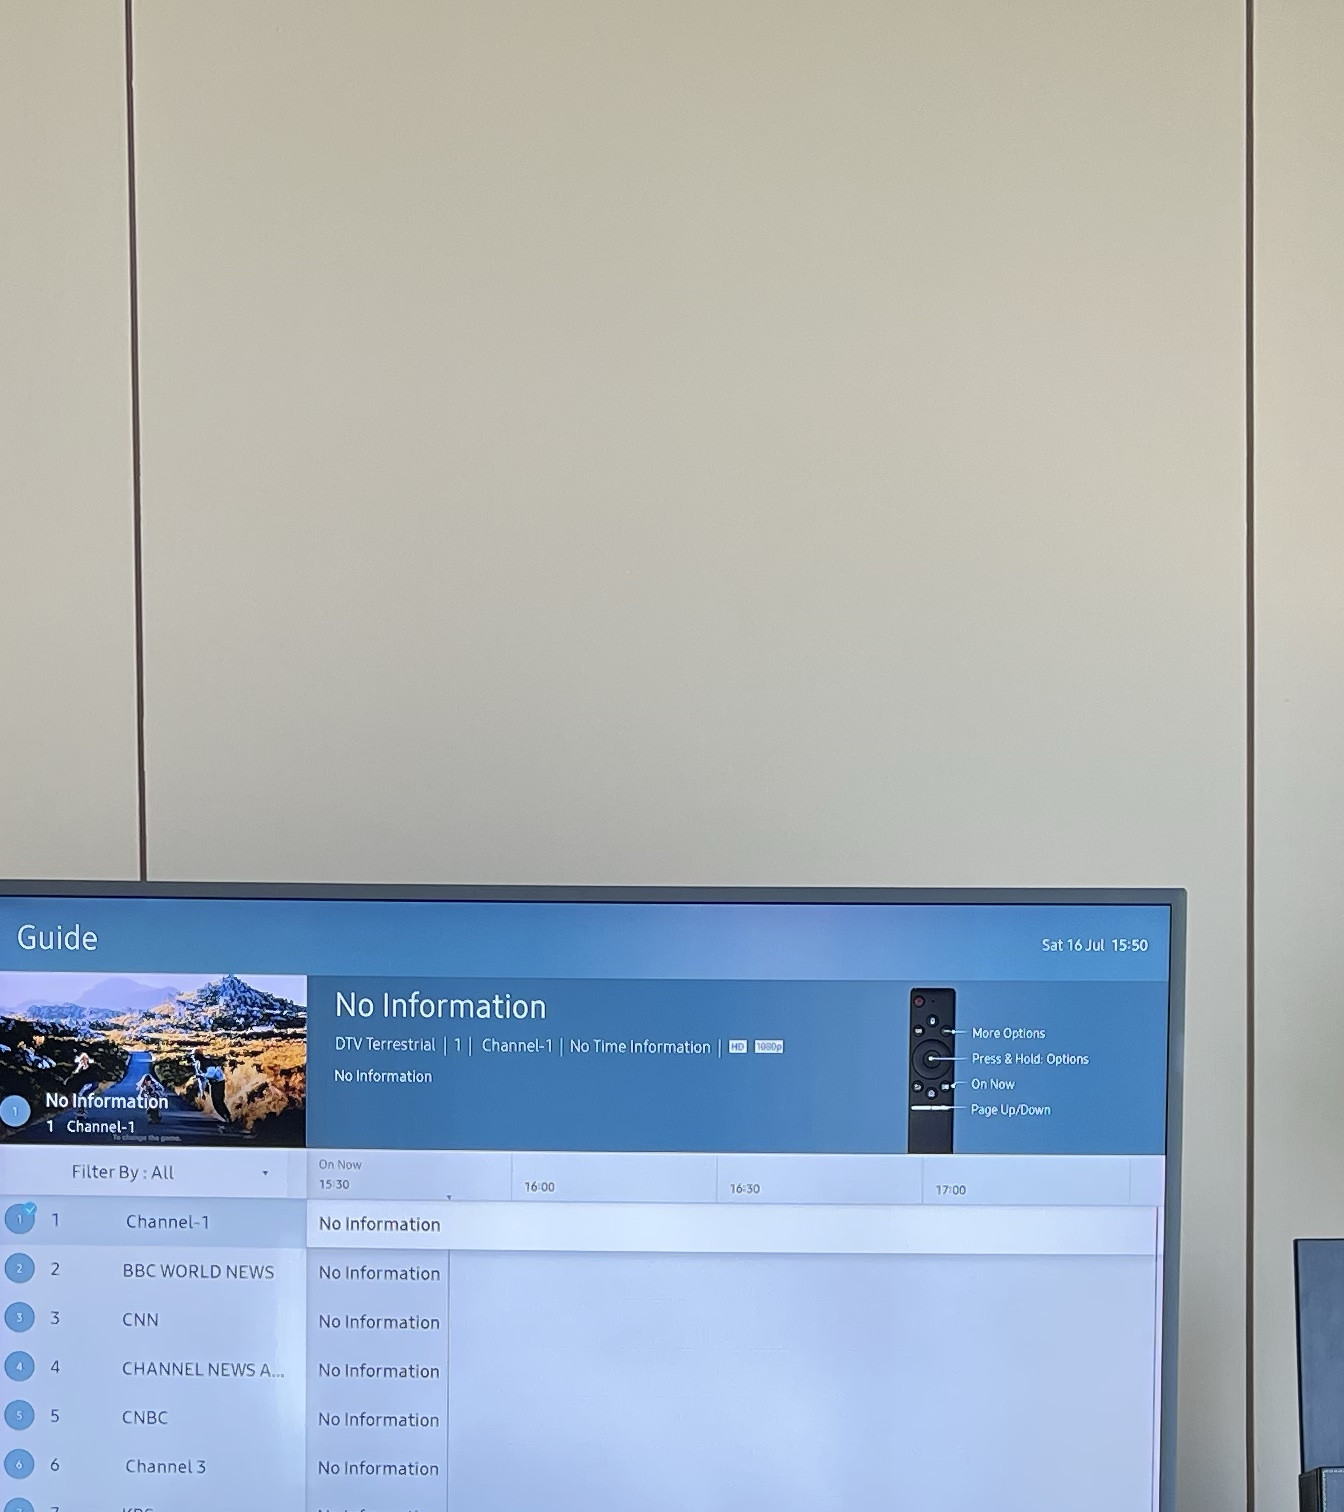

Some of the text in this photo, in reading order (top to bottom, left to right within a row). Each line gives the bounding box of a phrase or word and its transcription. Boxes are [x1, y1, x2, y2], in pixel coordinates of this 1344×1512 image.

[17, 923, 99, 951] Guide
[1042, 937, 1150, 953] Sat 16 Jul 15:50
[336, 990, 547, 1019] No Information
[971, 1027, 1047, 1041] More Options
[335, 1036, 364, 1051] DTV
[365, 1036, 436, 1052] Terrestrial
[454, 1037, 462, 1052] 1
[481, 1037, 553, 1053] Channel-1
[570, 1038, 591, 1053] No
[592, 1038, 627, 1054] Time
[630, 1038, 711, 1054] Information
[972, 1052, 1003, 1066] Press
[1004, 1052, 1014, 1065] &
[1045, 1052, 1091, 1067] Options
[334, 1068, 434, 1083] No Information
[971, 1077, 1017, 1090] On Now
[45, 1092, 169, 1110] No Information
[971, 1103, 1053, 1118] Page Up/Down
[46, 1119, 135, 1134] 1 Channel-1
[318, 1159, 363, 1170] On Now
[72, 1164, 115, 1179] Filter
[119, 1165, 139, 1183] By
[151, 1165, 174, 1180] All
[319, 1179, 350, 1190] 15:30
[524, 1180, 555, 1192] 16:00
[730, 1183, 761, 1194] 16:30
[936, 1184, 967, 1196] 17:00
[52, 1212, 59, 1227] 1
[126, 1214, 208, 1229] Channel-1
[319, 1215, 441, 1232] No Information
[51, 1261, 60, 1276] 2
[123, 1263, 155, 1278] BBC
[160, 1263, 222, 1279] WORLD
[226, 1264, 275, 1279] NEWS
[319, 1264, 440, 1281] No Information
[50, 1310, 60, 1325] 3
[122, 1312, 159, 1327] CNN
[319, 1313, 440, 1330] No Information
[50, 1359, 60, 1374] 4
[122, 1361, 204, 1377] CHANNEL
[208, 1362, 256, 1377] NEWS
[319, 1362, 440, 1379] No Information
[51, 1408, 60, 1423] 5
[122, 1410, 168, 1425] CNBC
[318, 1411, 439, 1427] No Information
[50, 1457, 60, 1472] 6
[125, 1459, 193, 1474] Channel
[196, 1459, 206, 1474] 3
[318, 1460, 439, 1476] No Information
